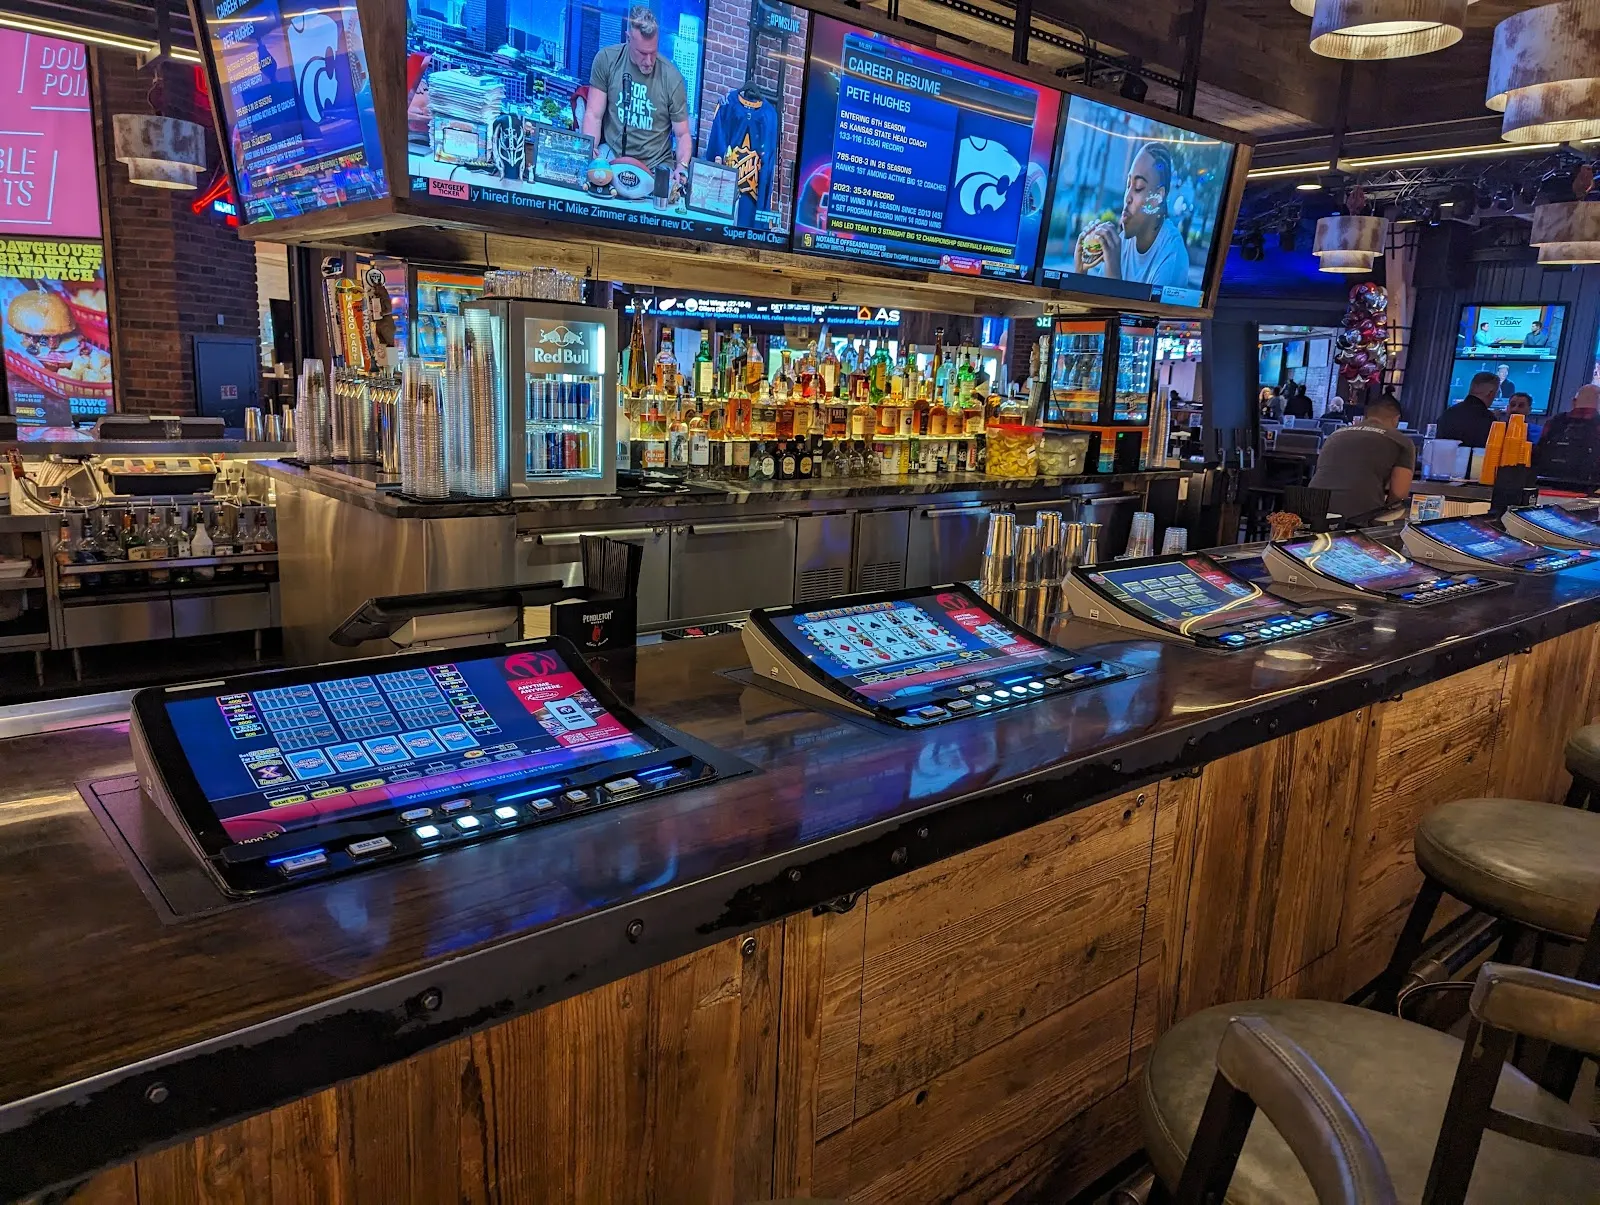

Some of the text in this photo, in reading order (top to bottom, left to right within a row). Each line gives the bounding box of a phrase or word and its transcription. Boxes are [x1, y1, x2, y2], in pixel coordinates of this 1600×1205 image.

[848, 57, 941, 96] CAREER RESUME
[846, 86, 911, 113] PETE HUGHES
[841, 110, 906, 133] ENTERING 6TH SEASON
[839, 132, 861, 143] 133-116
[882, 142, 904, 153] RECORD
[840, 121, 927, 148] AS KANSAS STATE HEAD COACH
[836, 163, 855, 173] RANKS
[856, 166, 866, 175] 1ST
[867, 169, 887, 180] AMONG
[888, 174, 906, 184] ACTIVE
[907, 177, 915, 186] BIG
[924, 181, 946, 192] COACHES
[878, 161, 886, 169] 26
[887, 163, 912, 175] SEASONS
[433, 181, 464, 193] SEATGEEK
[438, 189, 460, 197] TICKER
[833, 183, 894, 201] 2023: 35-24 RECORD
[482, 188, 509, 203] hired
[512, 194, 546, 210] former
[548, 200, 564, 212] HC
[566, 202, 589, 216] Mike
[590, 206, 626, 221] Zimmer
[628, 214, 638, 223] as
[640, 214, 660, 226] their
[661, 220, 680, 229] new
[681, 221, 694, 232] DC
[723, 226, 746, 240] Super
[747, 230, 766, 242] Bowl
[832, 193, 848, 202] MOST
[850, 196, 865, 206] WINS
[879, 202, 900, 212] SEASON
[901, 206, 916, 215] SINCE
[918, 208, 931, 217] 2013
[932, 210, 943, 220] (45)
[847, 206, 872, 217] PROGRAM
[873, 210, 893, 221] RECORD
[894, 214, 907, 222] WITH
[908, 215, 914, 224] 14
[915, 217, 928, 226] ROAD
[929, 219, 941, 228] WINS
[816, 235, 886, 251] NOTABLE OFFSEASON MOVES
[831, 220, 842, 228] HAS
[882, 228, 905, 237] STRAIGHT
[922, 234, 956, 246] CHAMPIONSHIP
[957, 239, 982, 250] SEMIFINALS
[983, 243, 1012, 255] APPEARANCES
[346, 294, 355, 330] MANGO
[875, 308, 900, 321] AS
[534, 348, 588, 365] Red Bull
[69, 398, 107, 406] DAWG
[70, 406, 107, 414] HOUSE
[583, 611, 612, 623] PENDLETON
[406, 787, 450, 800] Welcome
[463, 777, 496, 788] Resorts
[497, 771, 523, 781] World
[540, 763, 564, 773] Vegas
